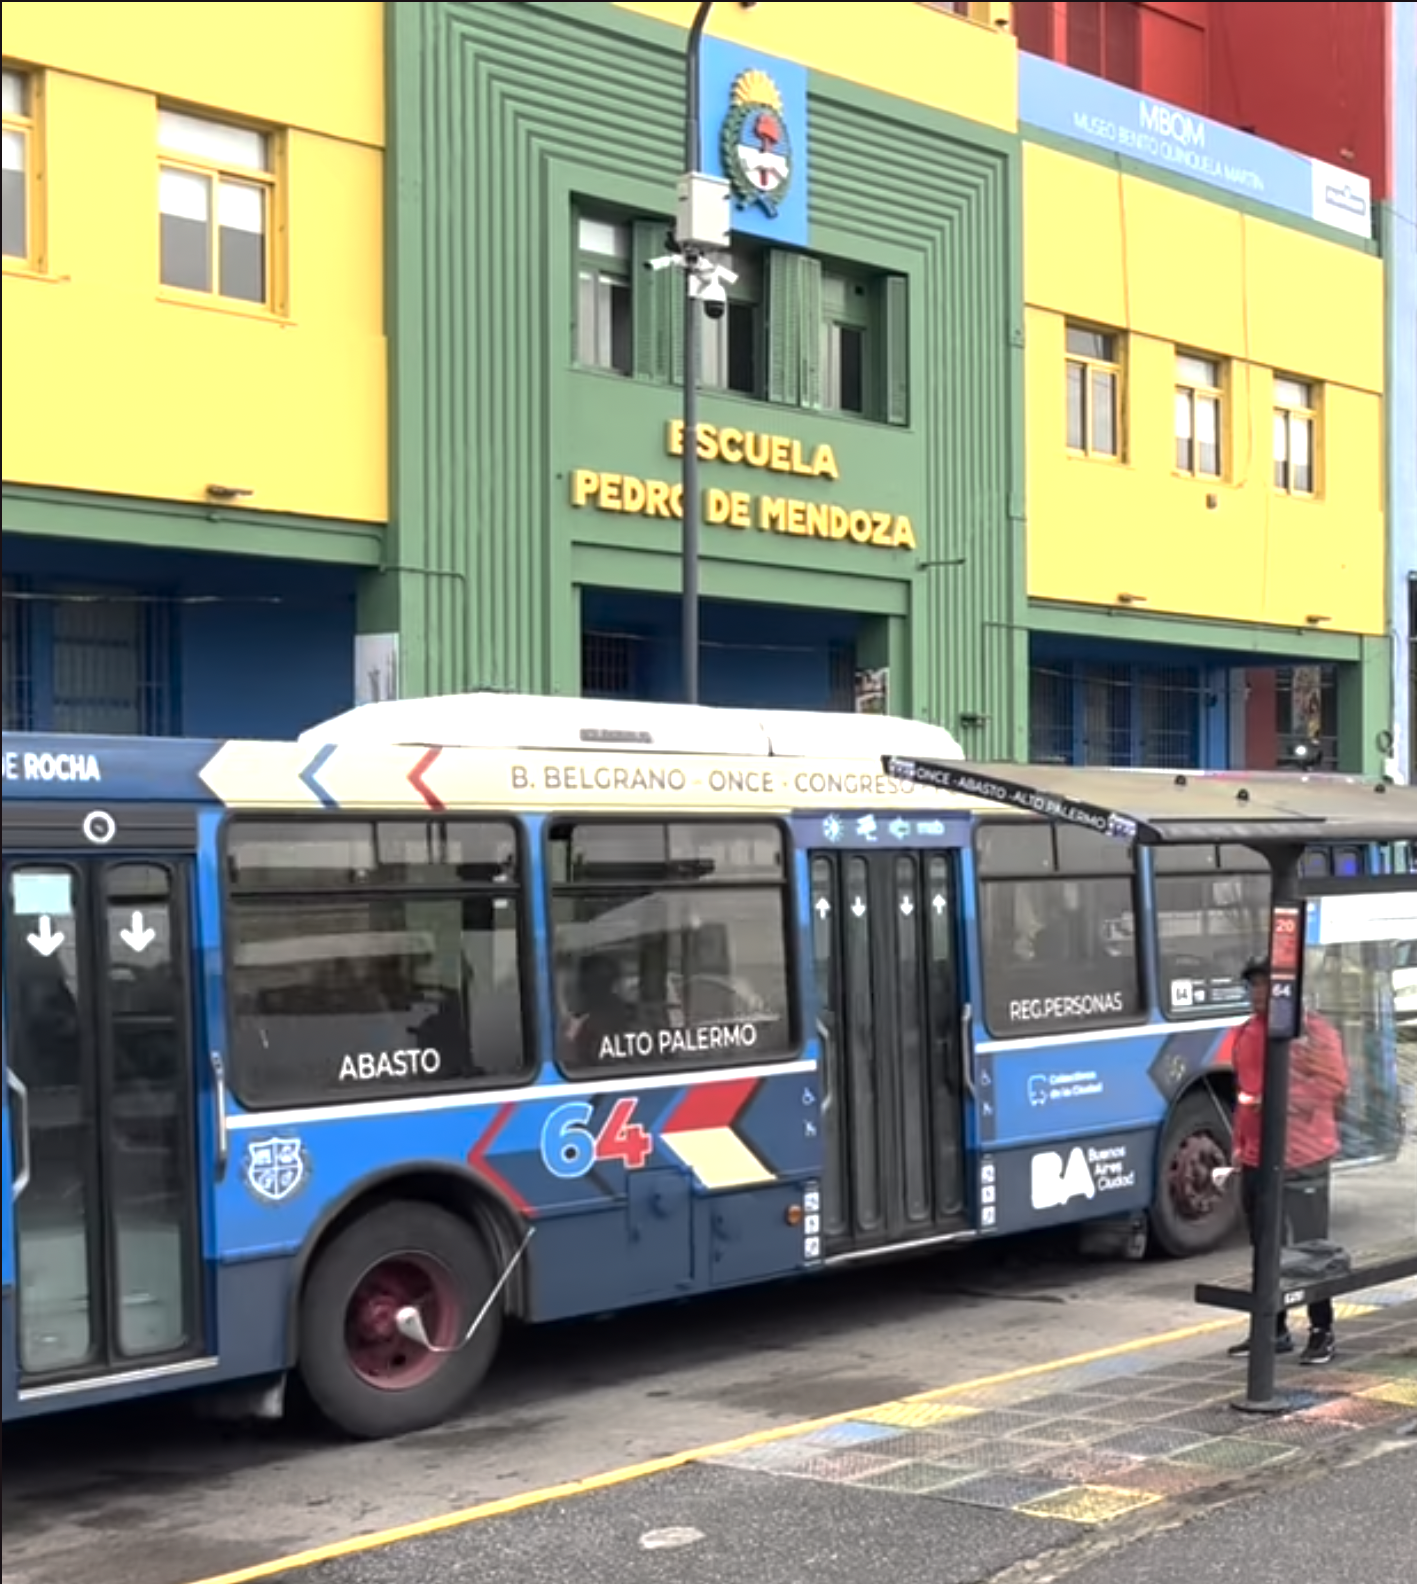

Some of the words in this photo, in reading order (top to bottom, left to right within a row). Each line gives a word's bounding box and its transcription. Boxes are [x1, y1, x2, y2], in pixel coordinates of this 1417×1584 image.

[1139, 99, 1205, 148] MBQM
[1073, 111, 1116, 141] MUSEO
[1118, 125, 1158, 156] BENITO
[1160, 141, 1223, 177] QUINQUELA
[667, 418, 838, 479] ESCUELA
[706, 487, 751, 528] DE
[760, 495, 916, 549] MENDOZA
[24, 752, 101, 781] ROCHA
[511, 765, 536, 790] B.
[544, 766, 686, 790] BELGRANO
[708, 769, 774, 793] ONCE
[794, 772, 915, 795] CONGRESO
[916, 767, 951, 786] ONCE
[956, 776, 1007, 800] ABASTO
[1012, 789, 1045, 811] ALTO
[1046, 799, 1107, 831] PALERMO
[1275, 919, 1296, 933] 20
[1009, 991, 1123, 1021] REG.PERSONAS
[1271, 983, 1292, 997] 64
[599, 1031, 653, 1059] ALTO
[658, 1023, 758, 1053] PALERMO
[338, 1047, 442, 1081] ABASTO
[540, 1096, 653, 1179] 64
[1088, 1145, 1126, 1163] Buenos
[1031, 1146, 1095, 1209] BA
[1095, 1161, 1122, 1175] Aires
[1098, 1169, 1135, 1191] Ciudad
